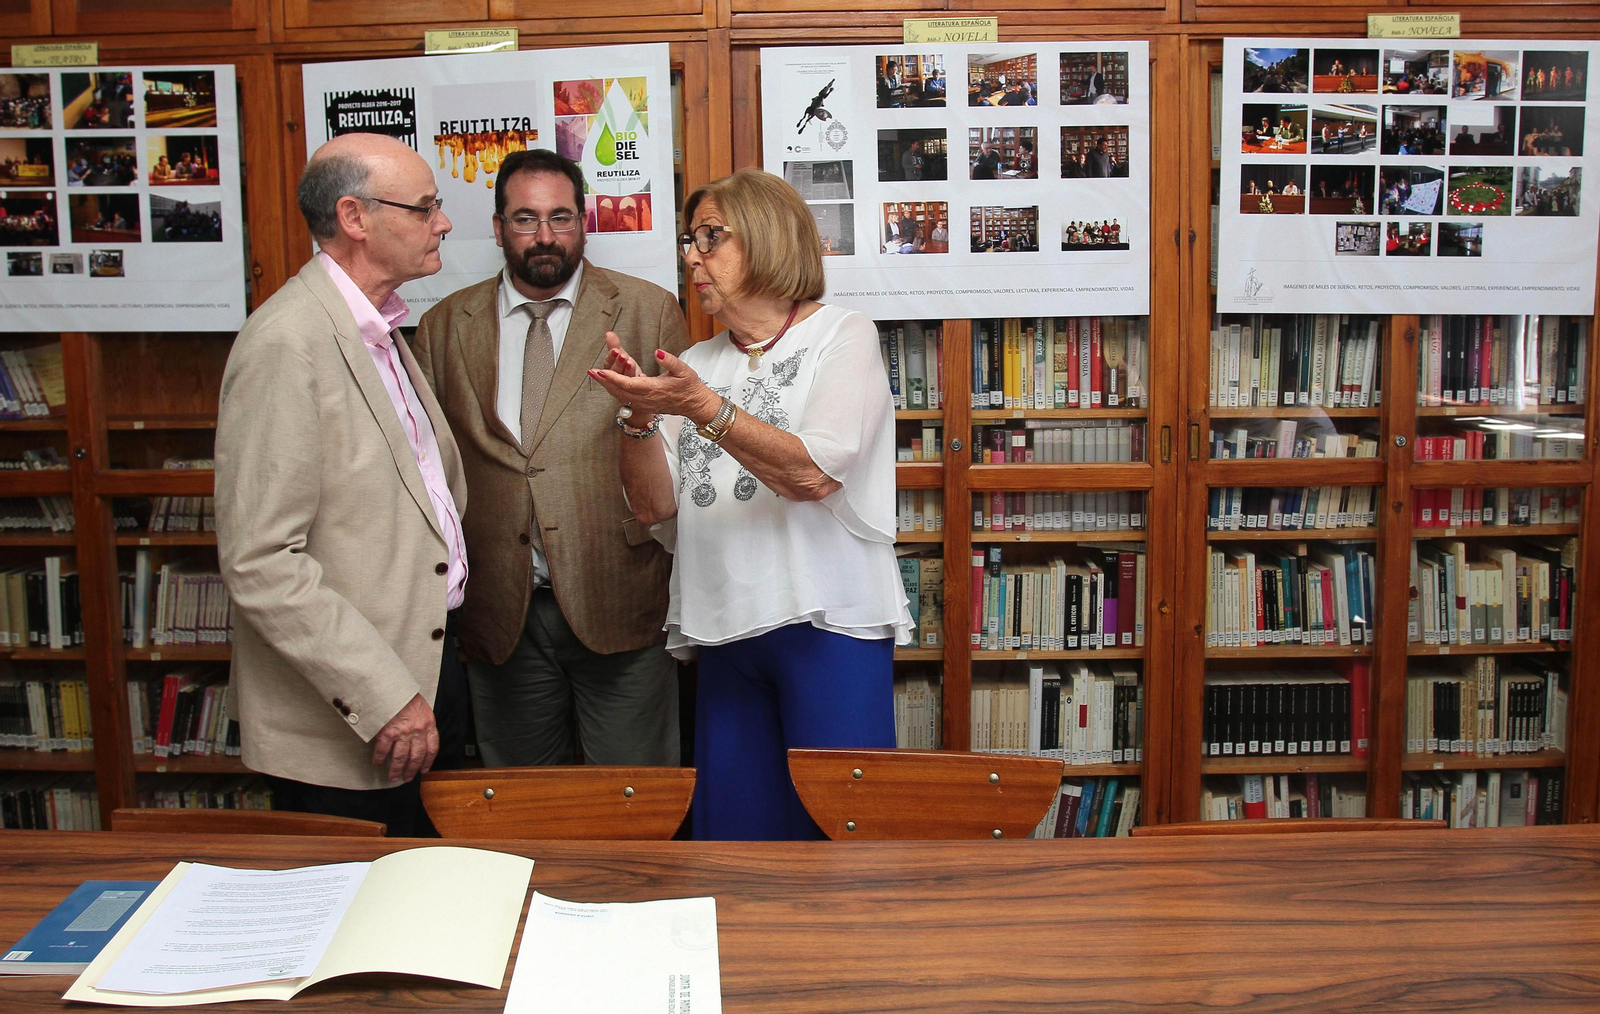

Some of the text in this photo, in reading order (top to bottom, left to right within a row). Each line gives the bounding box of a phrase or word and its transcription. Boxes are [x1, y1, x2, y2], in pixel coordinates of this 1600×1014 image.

[1408, 26, 1452, 36] NOVELA
[944, 32, 988, 42] NOVELA
[48, 55, 86, 64] TEATRO
[338, 110, 404, 128] REUTILIZA
[440, 116, 531, 134] REUTILIZA
[615, 131, 638, 141] BIO
[616, 140, 636, 150] DIE
[616, 150, 640, 160] SEL
[596, 170, 640, 178] REUTILIZA
[1431, 330, 1441, 354] 2013
[890, 331, 898, 378] EL GRIEGO
[1314, 354, 1323, 389] ABOGADO
[1553, 802, 1558, 810] DE
[680, 974, 690, 990] JUNTA
